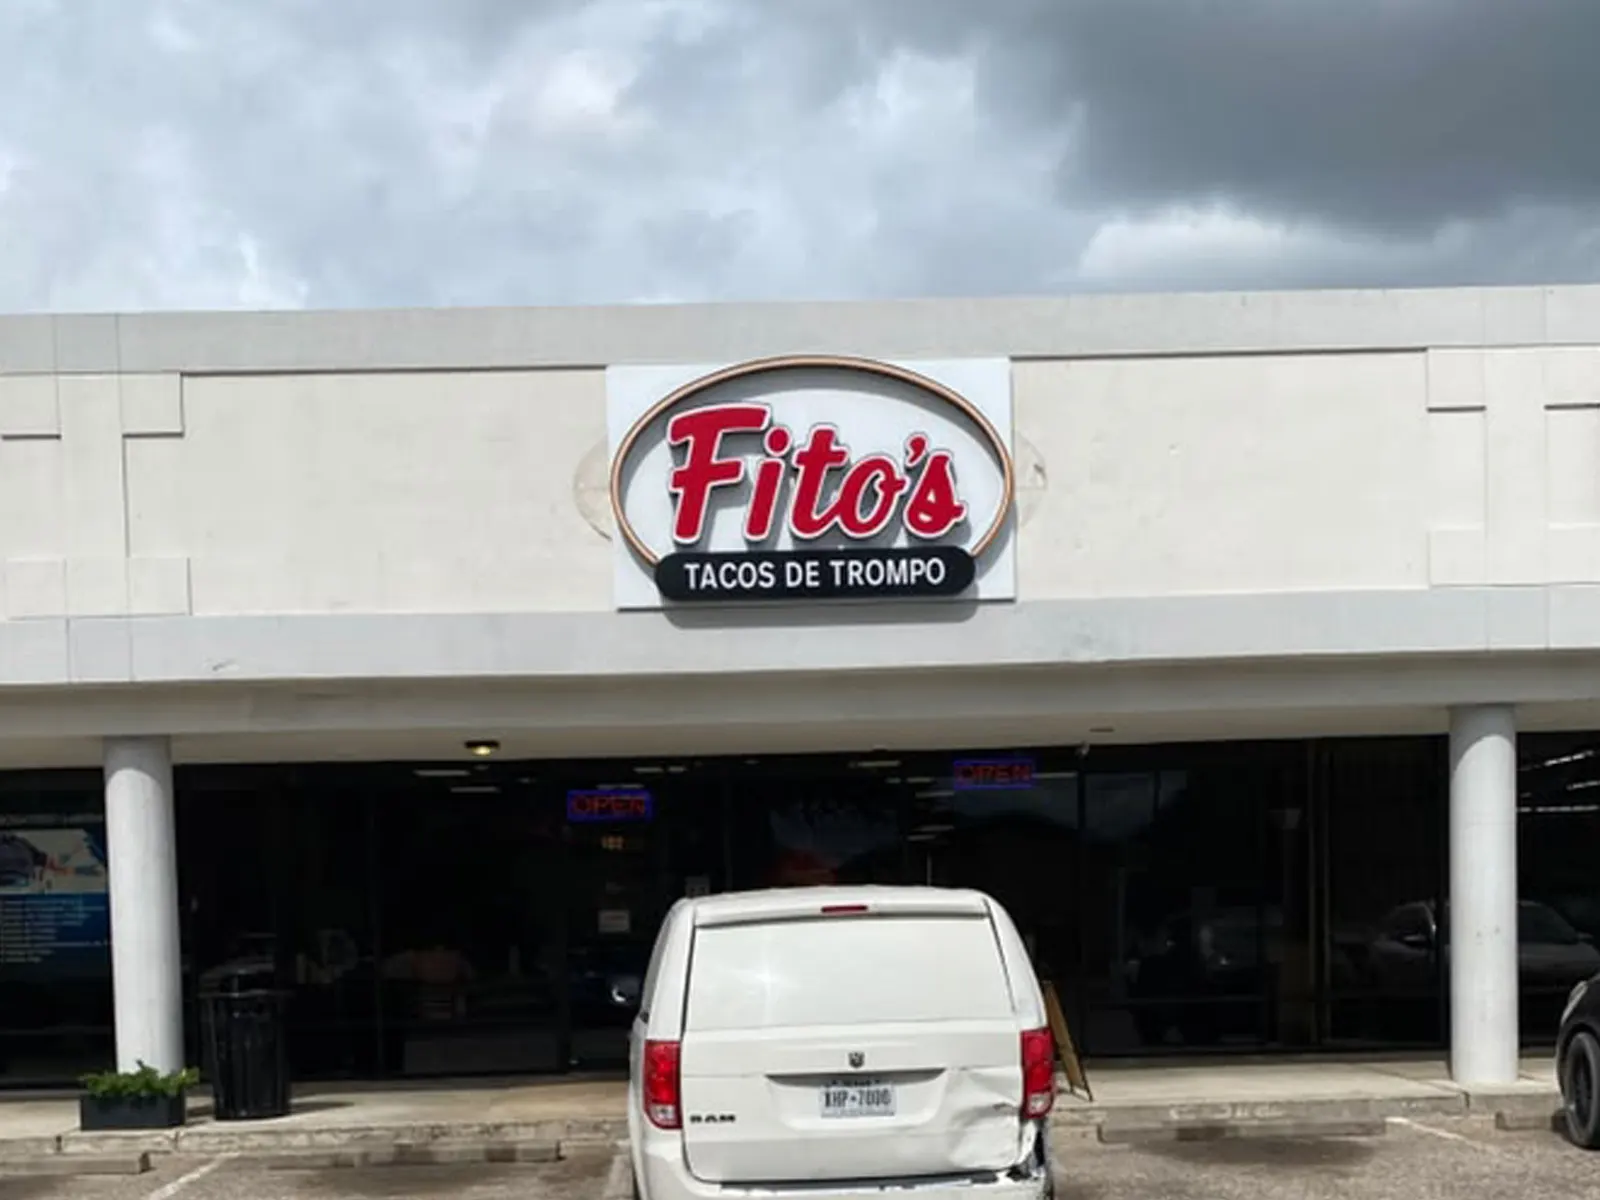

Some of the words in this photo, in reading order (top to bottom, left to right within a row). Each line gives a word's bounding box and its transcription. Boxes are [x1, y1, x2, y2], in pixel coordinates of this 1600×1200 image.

[668, 404, 966, 542] Fito's
[684, 562, 776, 592] TACOS
[785, 560, 820, 589] DE
[829, 557, 947, 588] TROMPO
